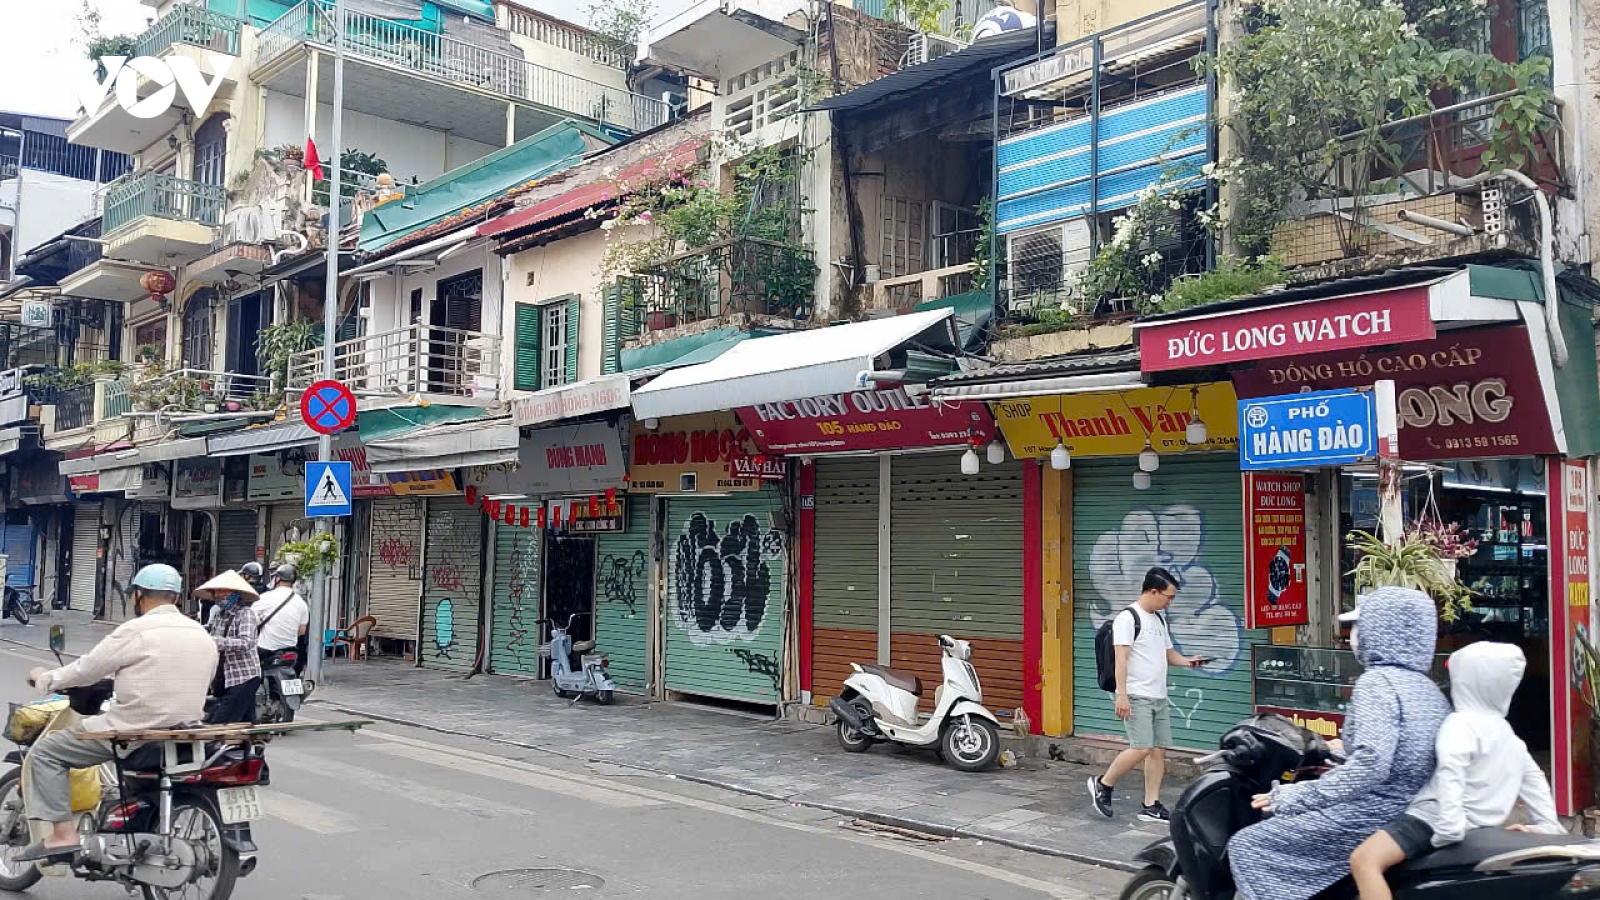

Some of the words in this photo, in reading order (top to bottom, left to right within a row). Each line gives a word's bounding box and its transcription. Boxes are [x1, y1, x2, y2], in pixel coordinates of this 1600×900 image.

[1168, 329, 1215, 359] ĐỨC
[1221, 324, 1287, 352] LONG
[1292, 309, 1392, 344] WATCH
[1268, 360, 1333, 385] ĐỒNG
[1337, 353, 1374, 377] HỒ
[1377, 355, 1427, 374] CAO
[1430, 343, 1483, 367] CẤP
[754, 392, 849, 422] FACTORY
[1002, 403, 1032, 419] SHOP
[1288, 400, 1330, 420] PHỐ
[1396, 378, 1514, 429] ONG
[816, 420, 845, 436] 105
[1039, 408, 1131, 438] Thanh
[1130, 404, 1192, 437] Vân
[1253, 425, 1313, 456] HÀNG
[1318, 420, 1364, 451] ĐÀO
[1490, 434, 1519, 447] 1565
[1256, 480, 1281, 492] WATCH
[1277, 496, 1296, 507] LONG
[1568, 556, 1587, 575] LONG
